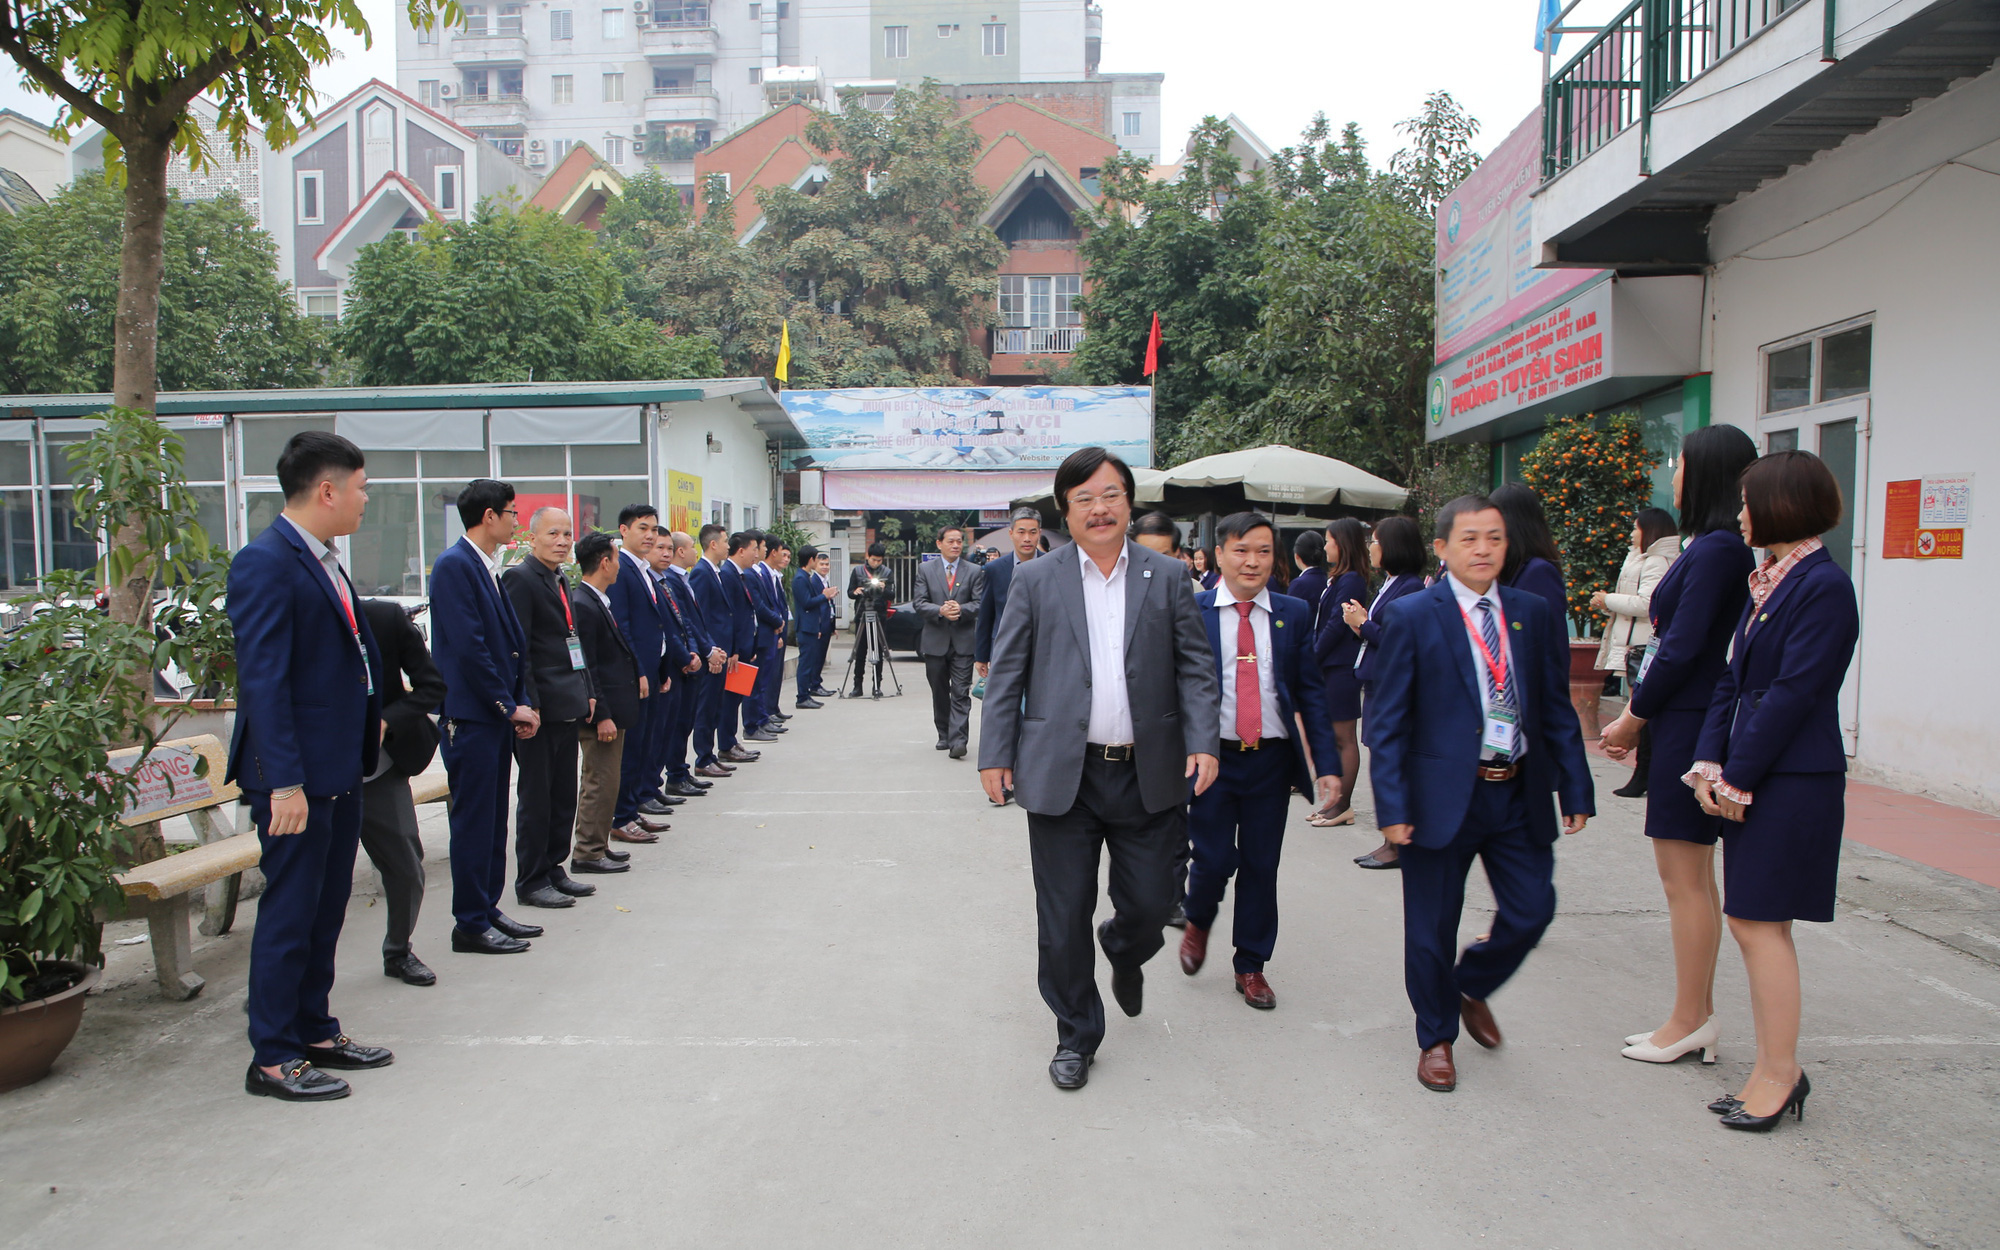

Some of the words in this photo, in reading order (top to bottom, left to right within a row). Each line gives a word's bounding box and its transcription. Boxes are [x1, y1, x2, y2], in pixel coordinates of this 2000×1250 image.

[1450, 378, 1499, 417] PHÒNG
[1501, 351, 1552, 397] TUYỂN
[1554, 332, 1602, 375] SINH
[1019, 415, 1062, 429] VCI
[1019, 453, 1053, 461] Website:
[1946, 545, 1961, 555] FIRE
